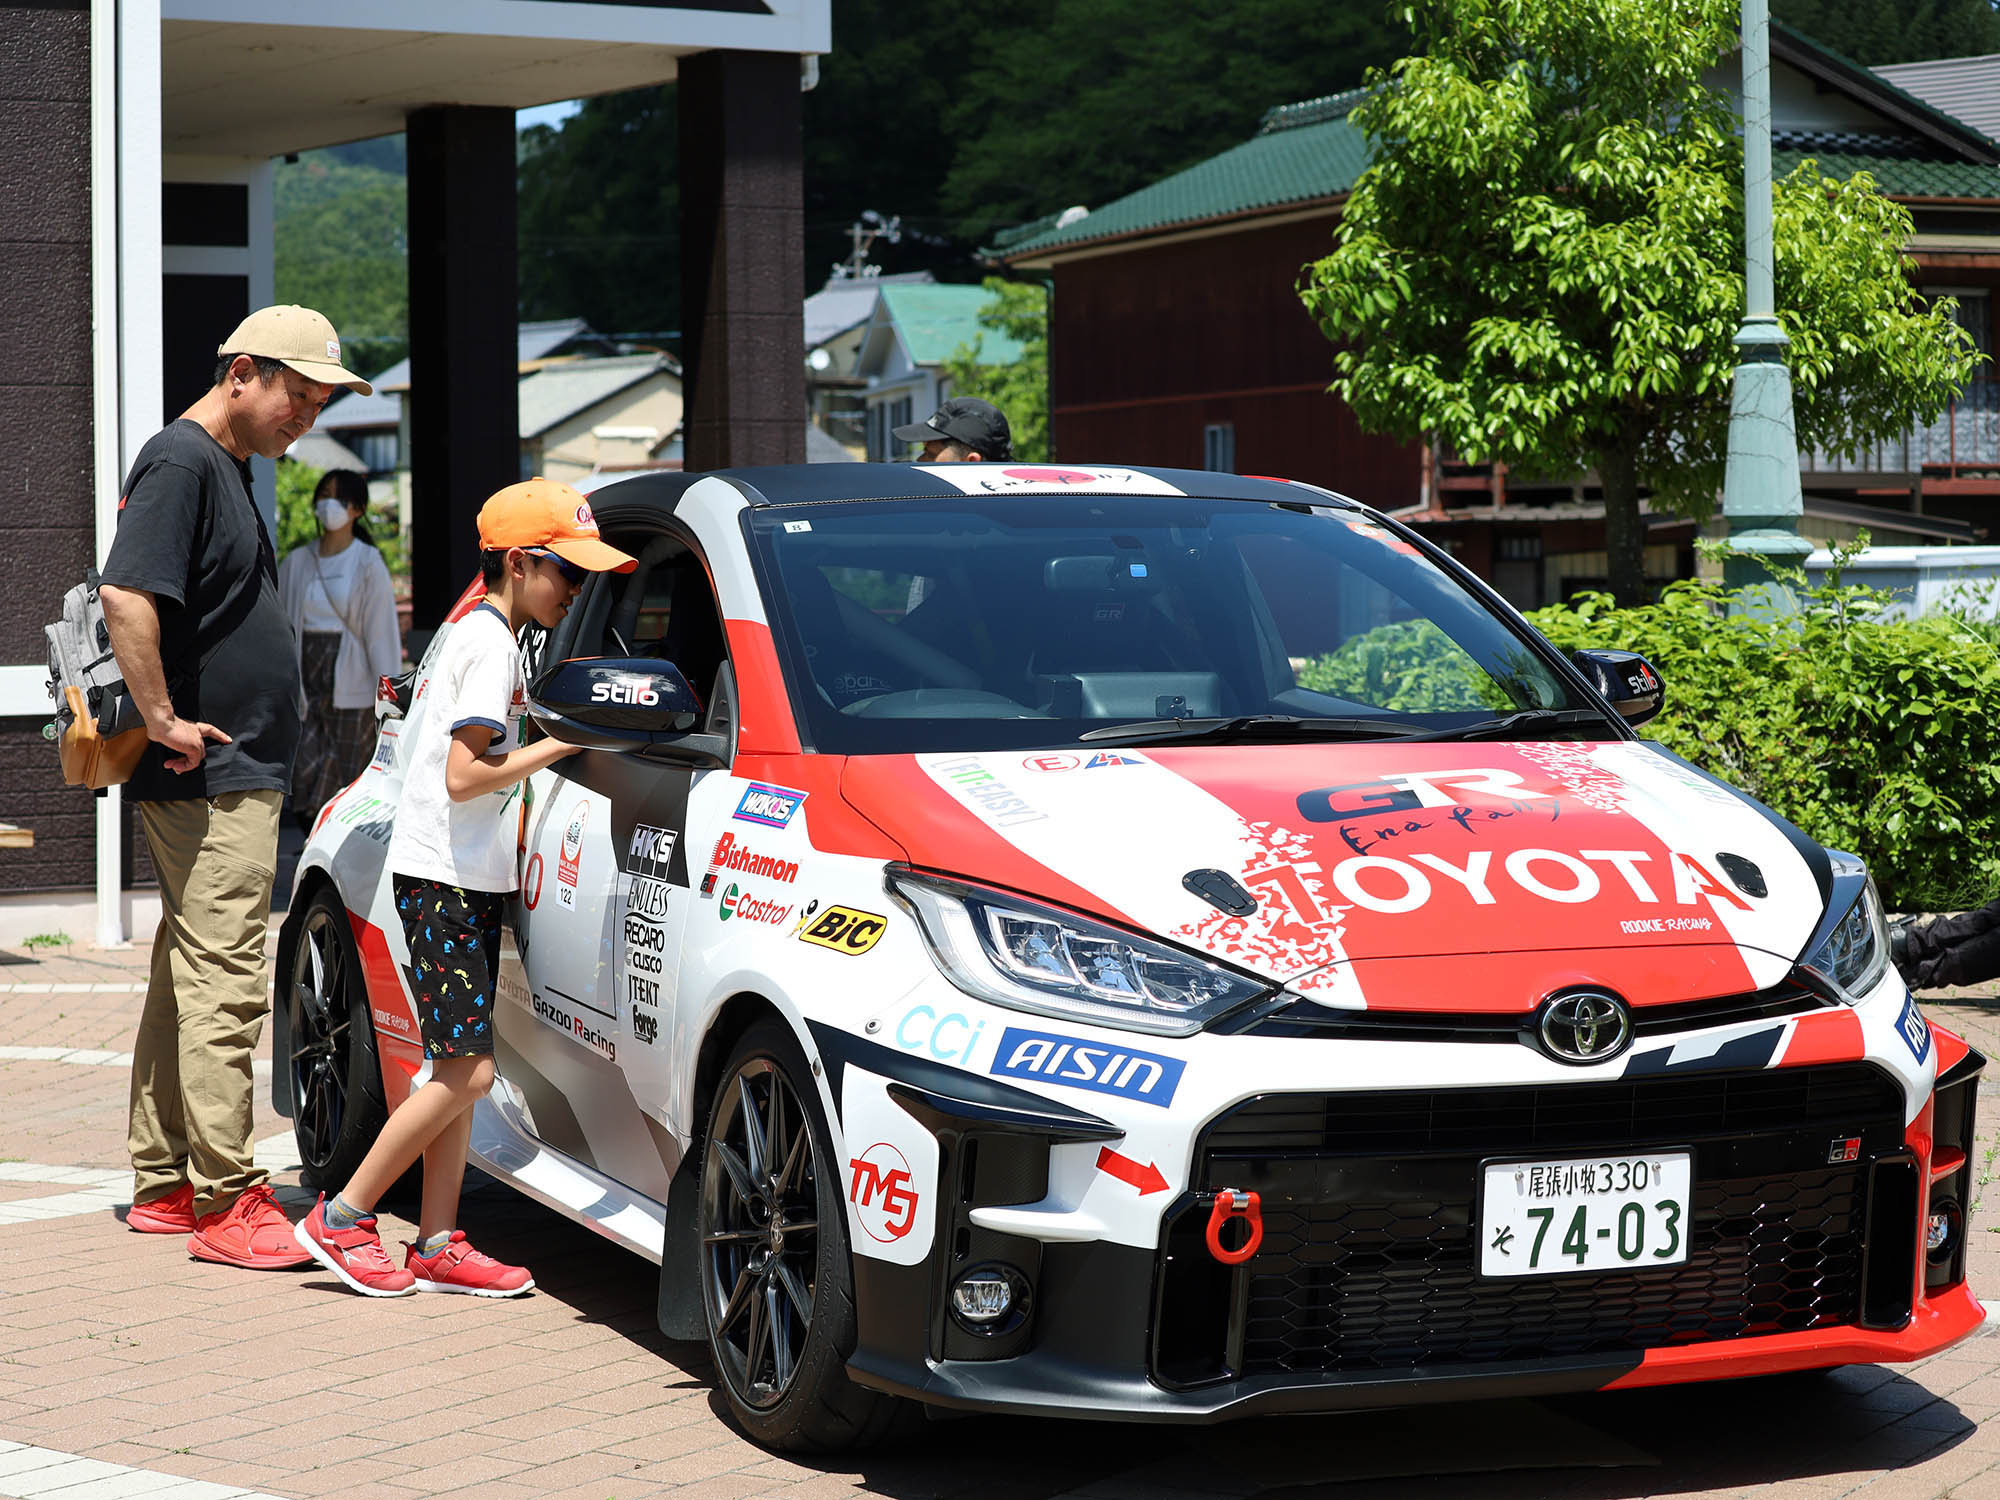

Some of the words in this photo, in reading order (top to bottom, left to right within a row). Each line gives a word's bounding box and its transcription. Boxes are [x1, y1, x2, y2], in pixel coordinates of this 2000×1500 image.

[1296, 768, 1554, 823] GR
[631, 828, 676, 864] HKS
[713, 832, 799, 883] Bishamon
[560, 887, 573, 905] 122
[627, 877, 671, 917] ENDLESS
[1243, 847, 1755, 925] TOYOTA
[737, 892, 795, 926] Castrol
[1620, 919, 1667, 934] ROOKIE
[624, 919, 665, 953] RECARO
[628, 974, 660, 1008] JTEKT
[500, 974, 531, 1007] OYOTA
[533, 993, 572, 1031] GAZOO
[574, 1016, 616, 1062] Racing
[1005, 1038, 1165, 1094] AISIN
[1830, 1147, 1858, 1161] GR
[1527, 1200, 1681, 1268] 74-03
